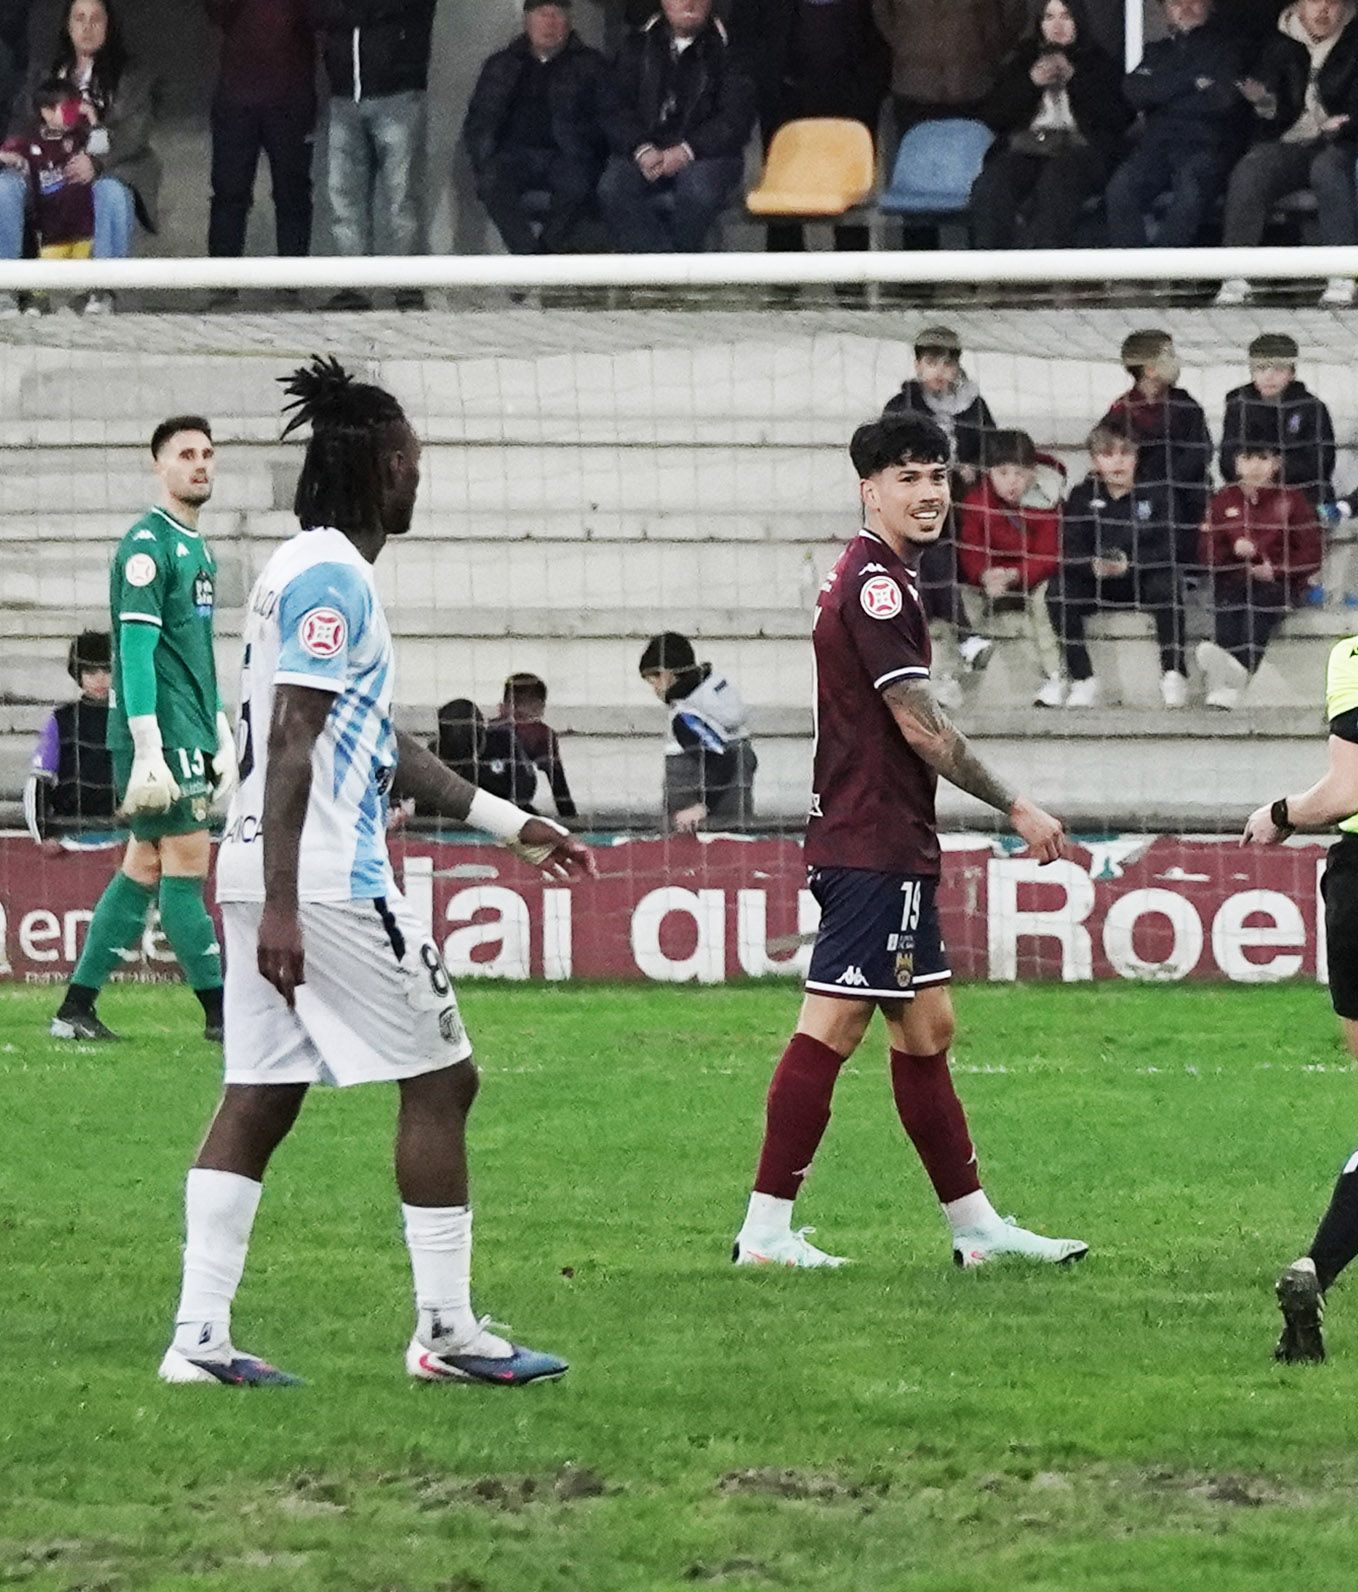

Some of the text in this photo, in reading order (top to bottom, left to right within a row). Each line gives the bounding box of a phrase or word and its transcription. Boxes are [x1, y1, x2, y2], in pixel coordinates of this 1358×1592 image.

[900, 881, 921, 931] 19
[631, 886, 822, 982] qu
[420, 943, 449, 996] 8
